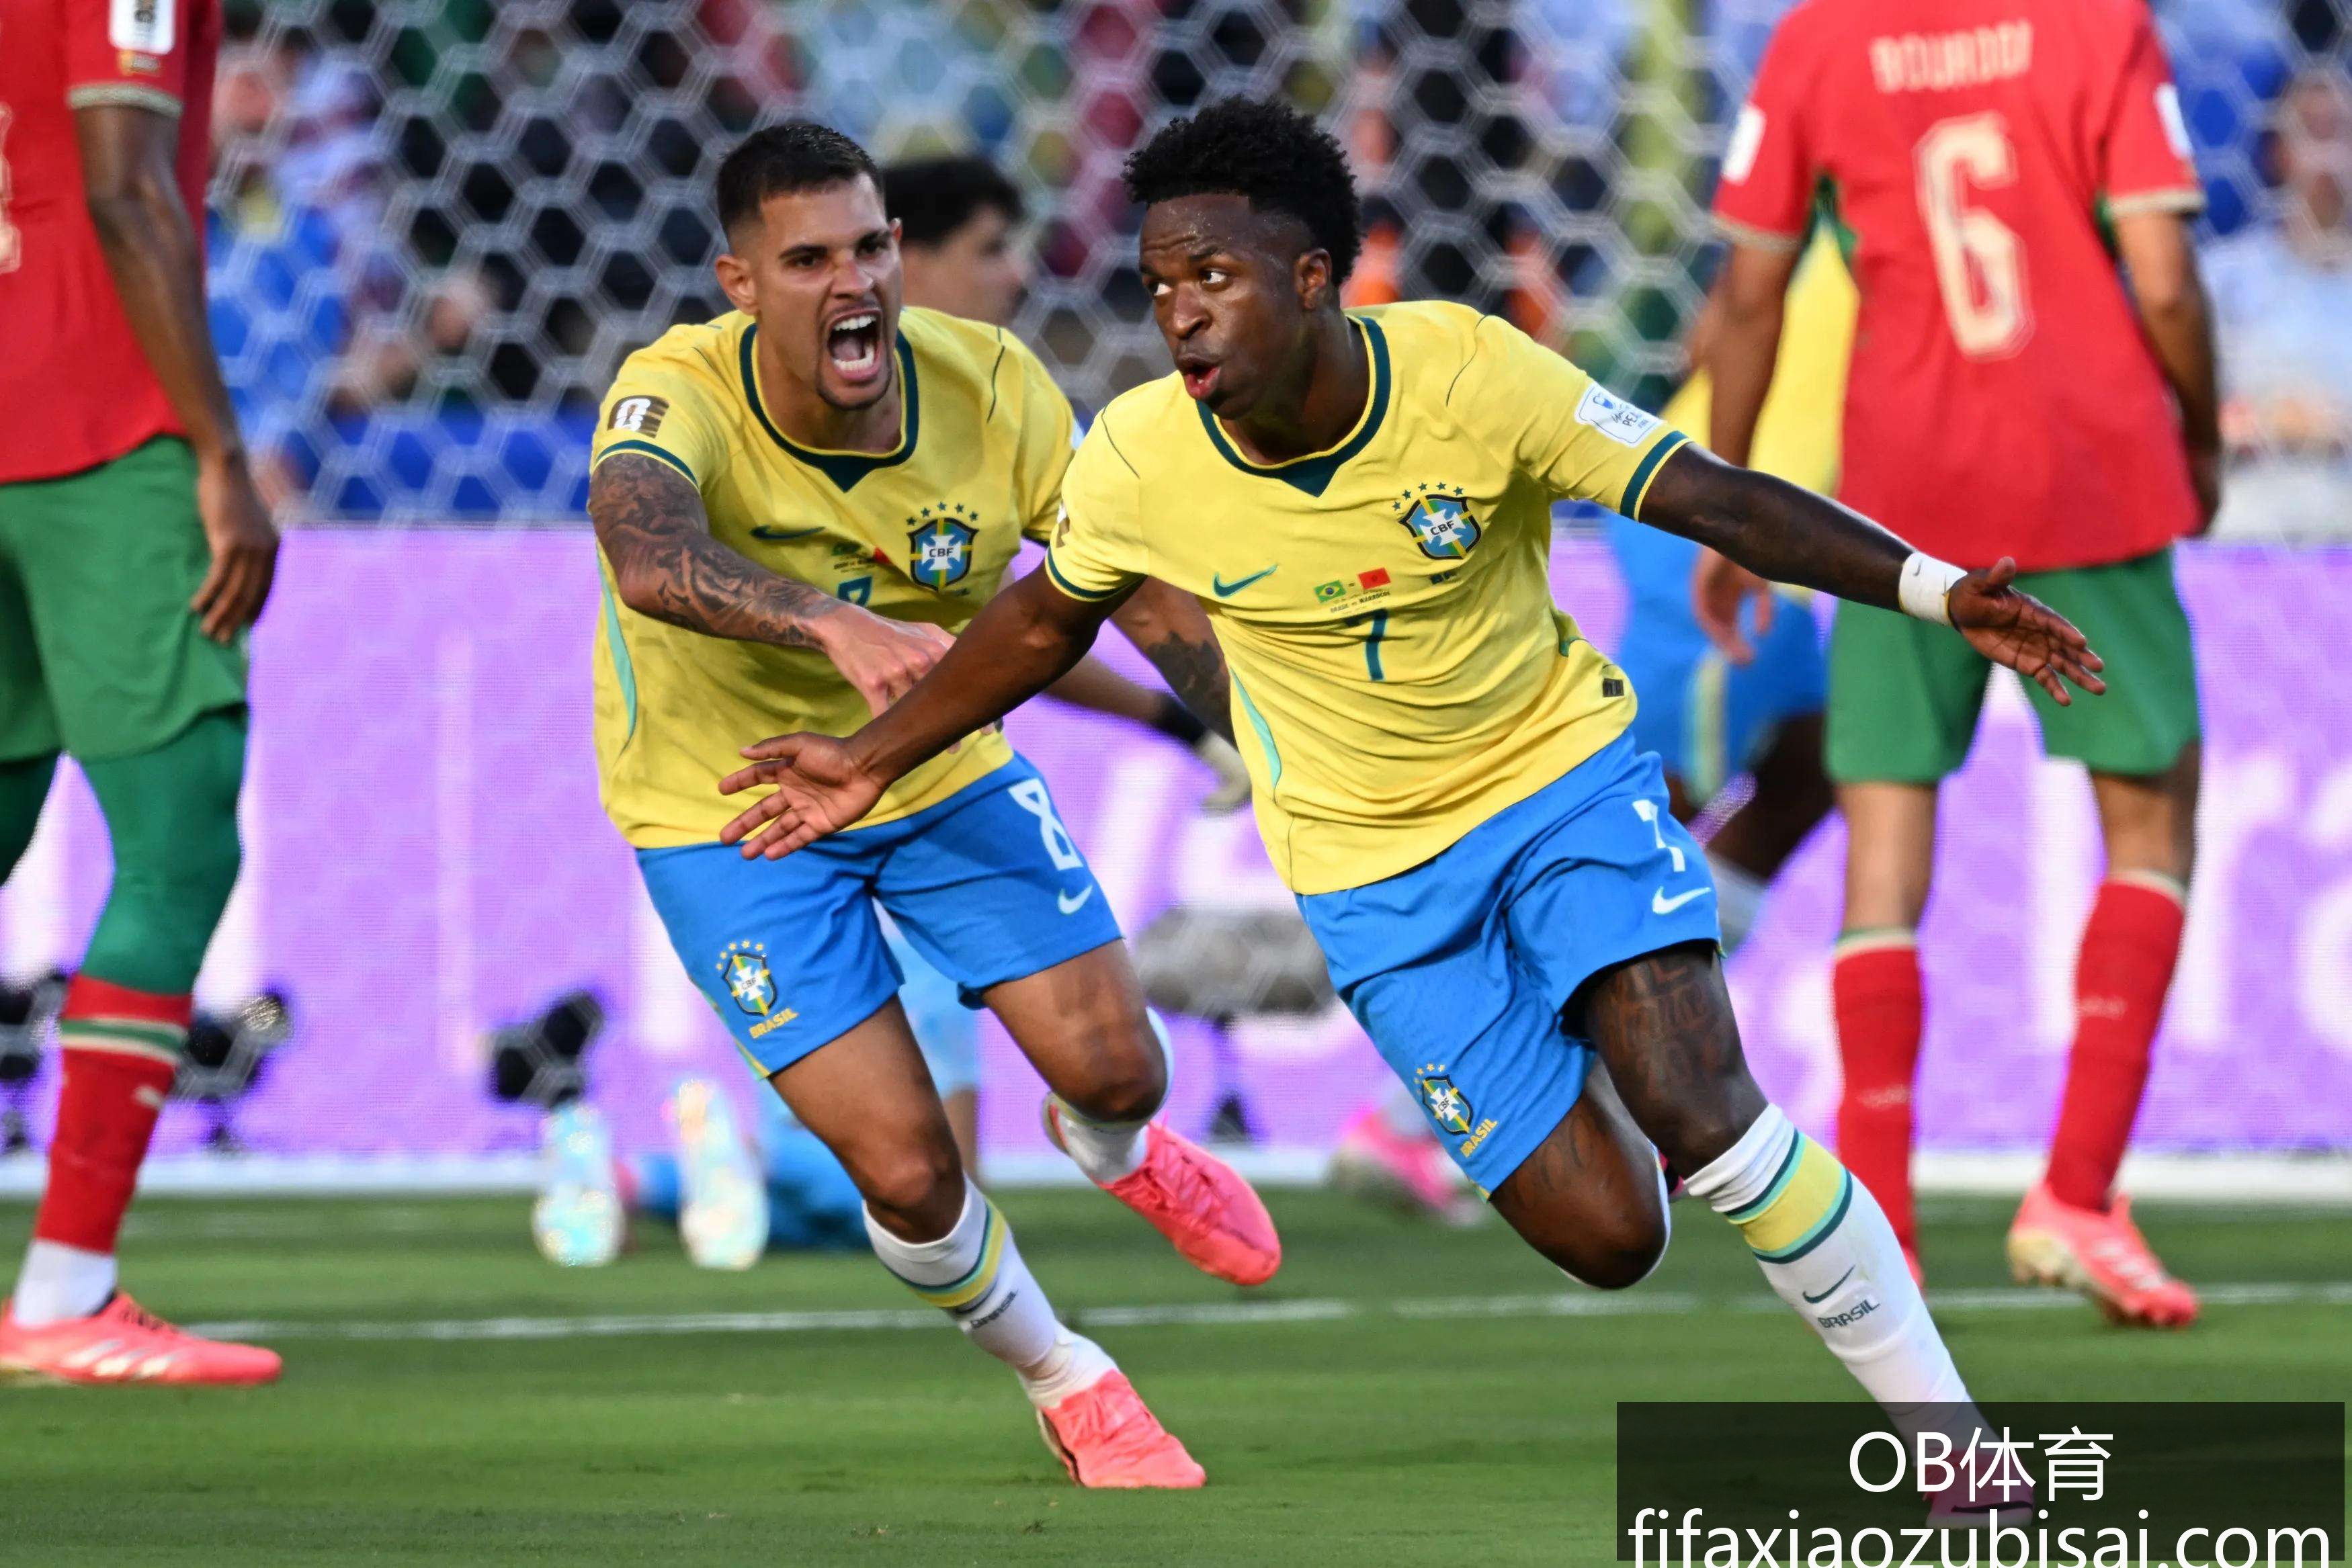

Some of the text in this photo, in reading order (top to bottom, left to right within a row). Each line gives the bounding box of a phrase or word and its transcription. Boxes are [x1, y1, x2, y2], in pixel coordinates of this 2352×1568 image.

[1913, 109, 2036, 363] 6
[1430, 520, 1454, 535] CBF
[929, 548, 954, 558] CBF
[1345, 607, 1387, 681] 7
[1008, 777, 1084, 871] 8
[1632, 799, 1686, 873] 7
[749, 1008, 799, 1039] BRASIL
[1437, 1096, 1450, 1112] CBF
[1460, 1118, 1498, 1158] BRASIL
[1817, 1299, 1881, 1329] BRASIL
